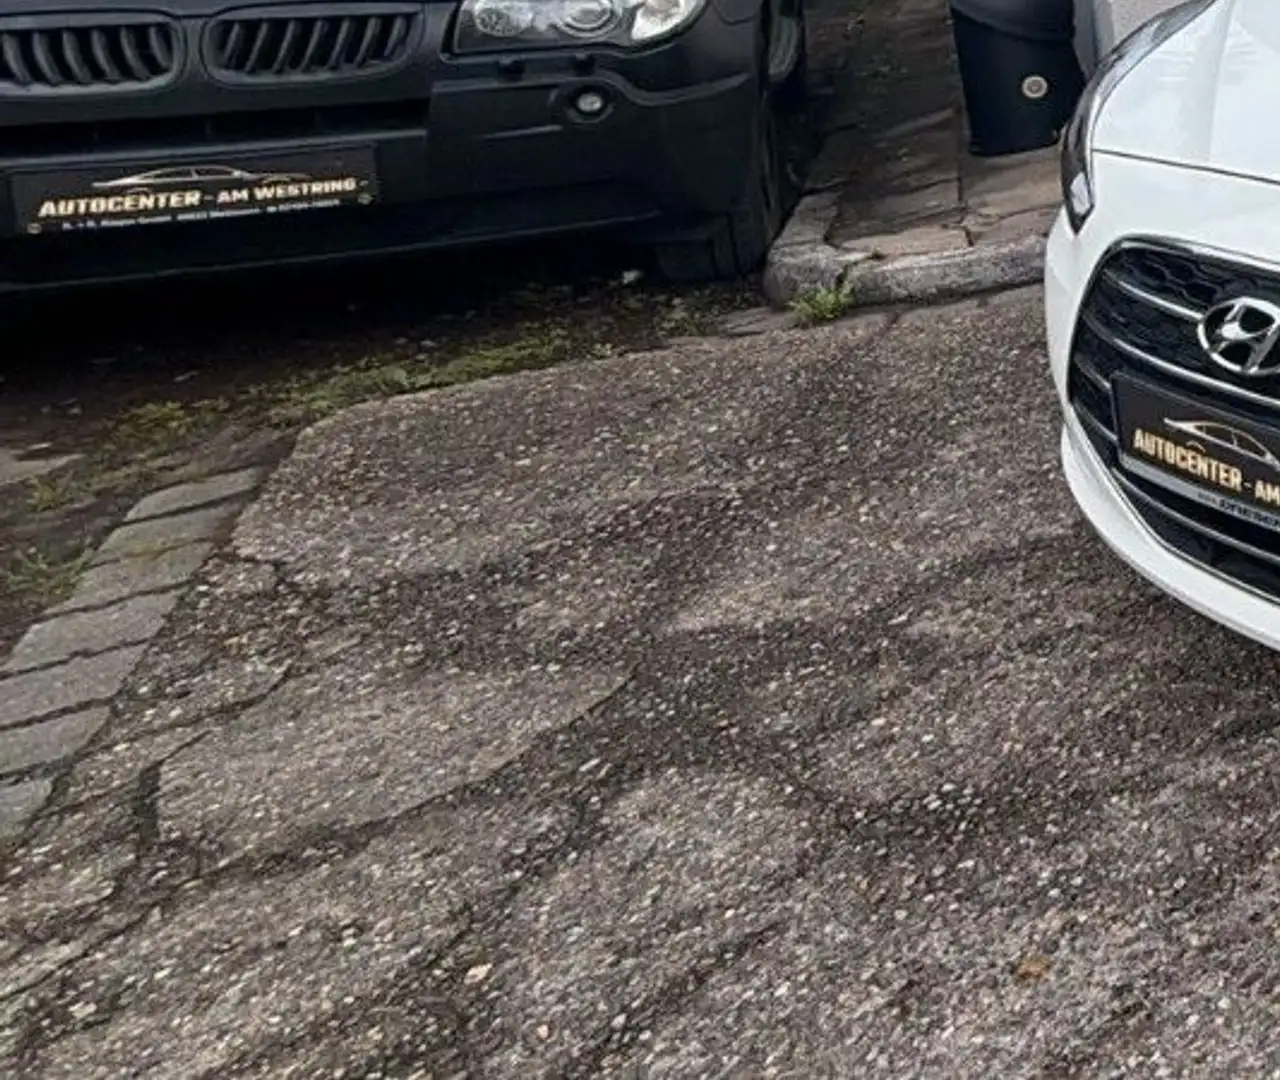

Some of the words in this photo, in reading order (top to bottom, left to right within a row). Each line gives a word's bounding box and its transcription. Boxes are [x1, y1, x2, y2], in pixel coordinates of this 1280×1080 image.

[38, 190, 202, 218] AUTOCENTER
[216, 188, 249, 205] AM
[253, 177, 357, 202] WESTRING
[1133, 428, 1243, 492] AUTOCENTER
